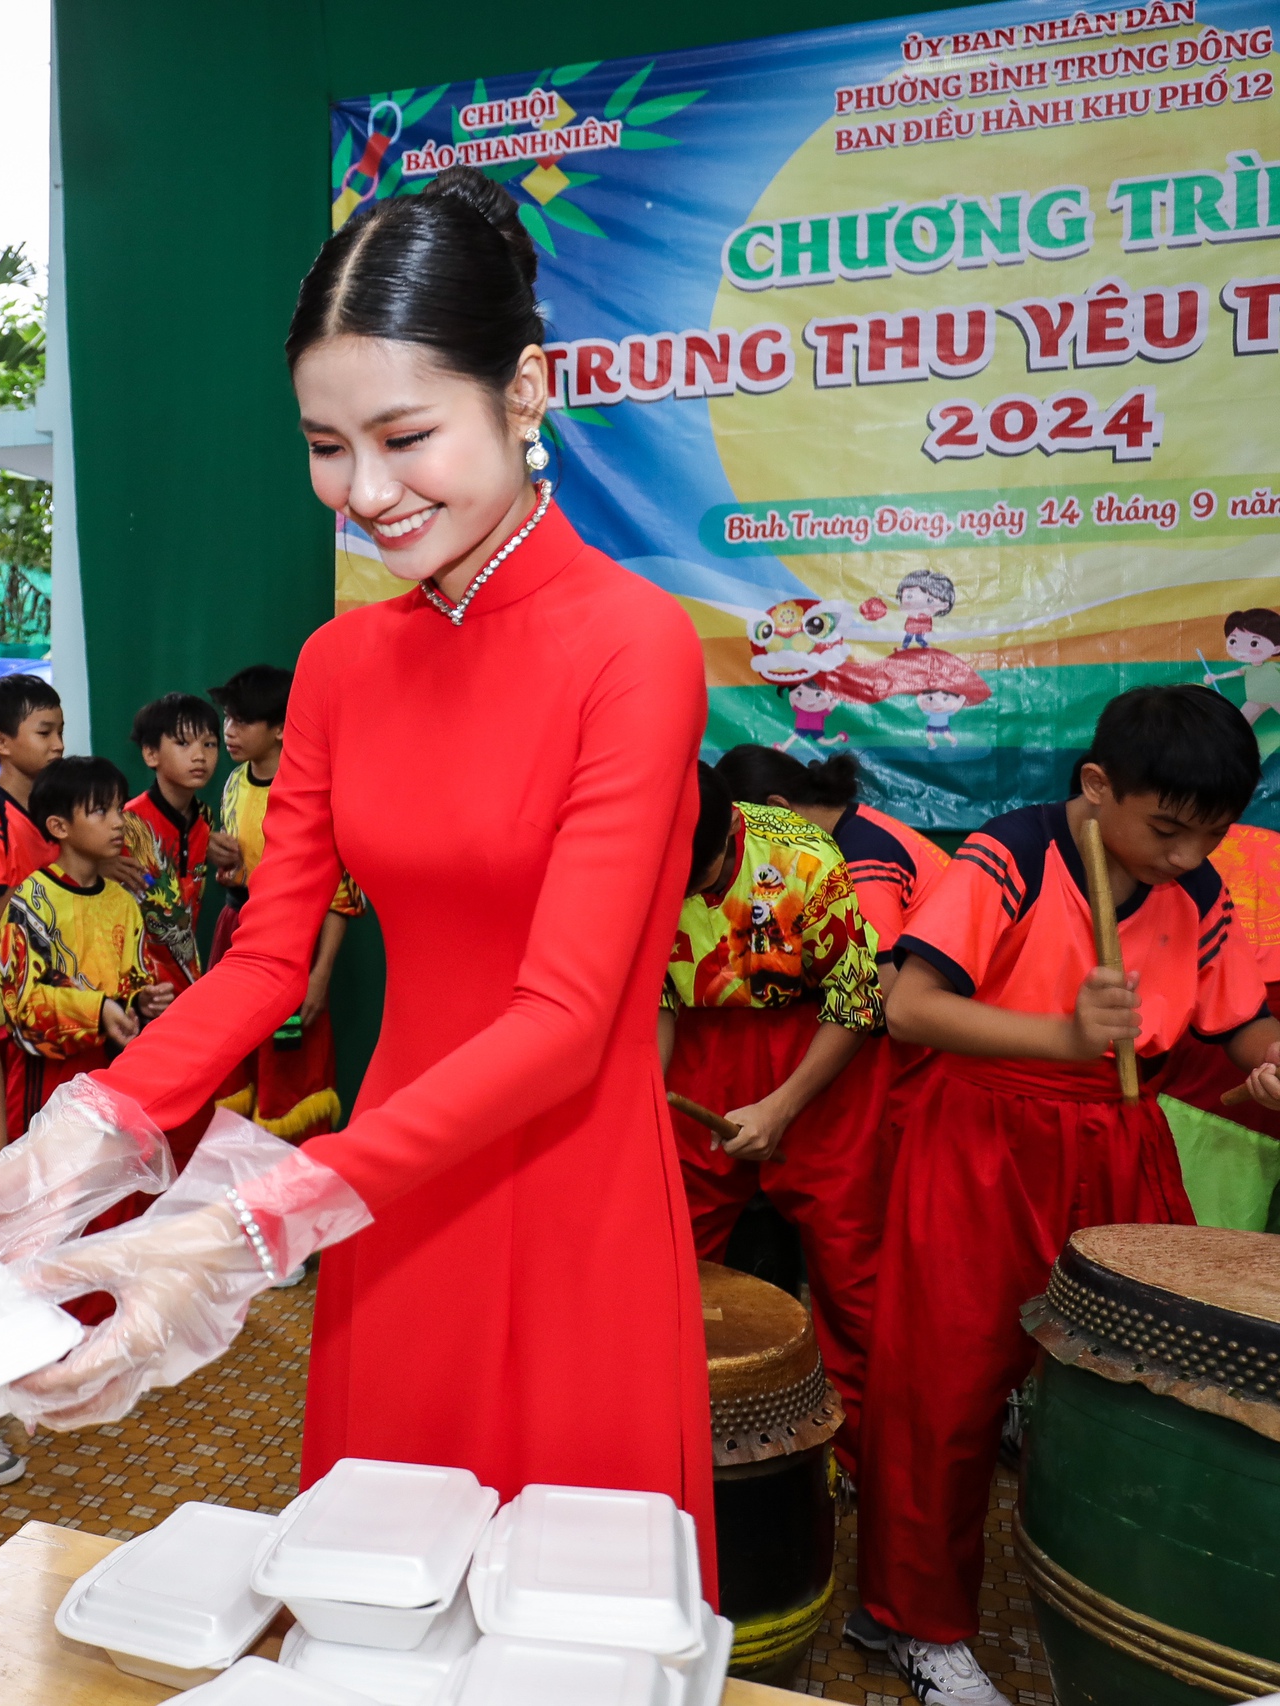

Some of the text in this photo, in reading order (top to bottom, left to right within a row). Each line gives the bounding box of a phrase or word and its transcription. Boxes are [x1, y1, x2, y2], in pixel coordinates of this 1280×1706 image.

[902, 1, 1196, 61] ỦY BAN NHÂN DÂN
[835, 29, 1273, 112] PHƯỜNG BÌNH TRƯNG ĐÔNG
[461, 90, 556, 127] CHI HỘI
[835, 68, 1274, 151] BAN ĐIỀU HÀNH KHU PHỐ 12
[404, 119, 620, 171] BÁO THANH NIÊN
[726, 188, 1088, 282] CHƯƠNG
[814, 308, 987, 376] THU
[1022, 282, 1199, 359] YÊU
[934, 392, 1154, 449] 2024
[727, 512, 788, 541] Bình
[790, 512, 870, 542] Trưng
[875, 506, 954, 538] Đông,
[960, 506, 1025, 536] ngày
[1038, 499, 1080, 525] 14
[1093, 495, 1177, 528] tháng
[1192, 491, 1214, 518] 9
